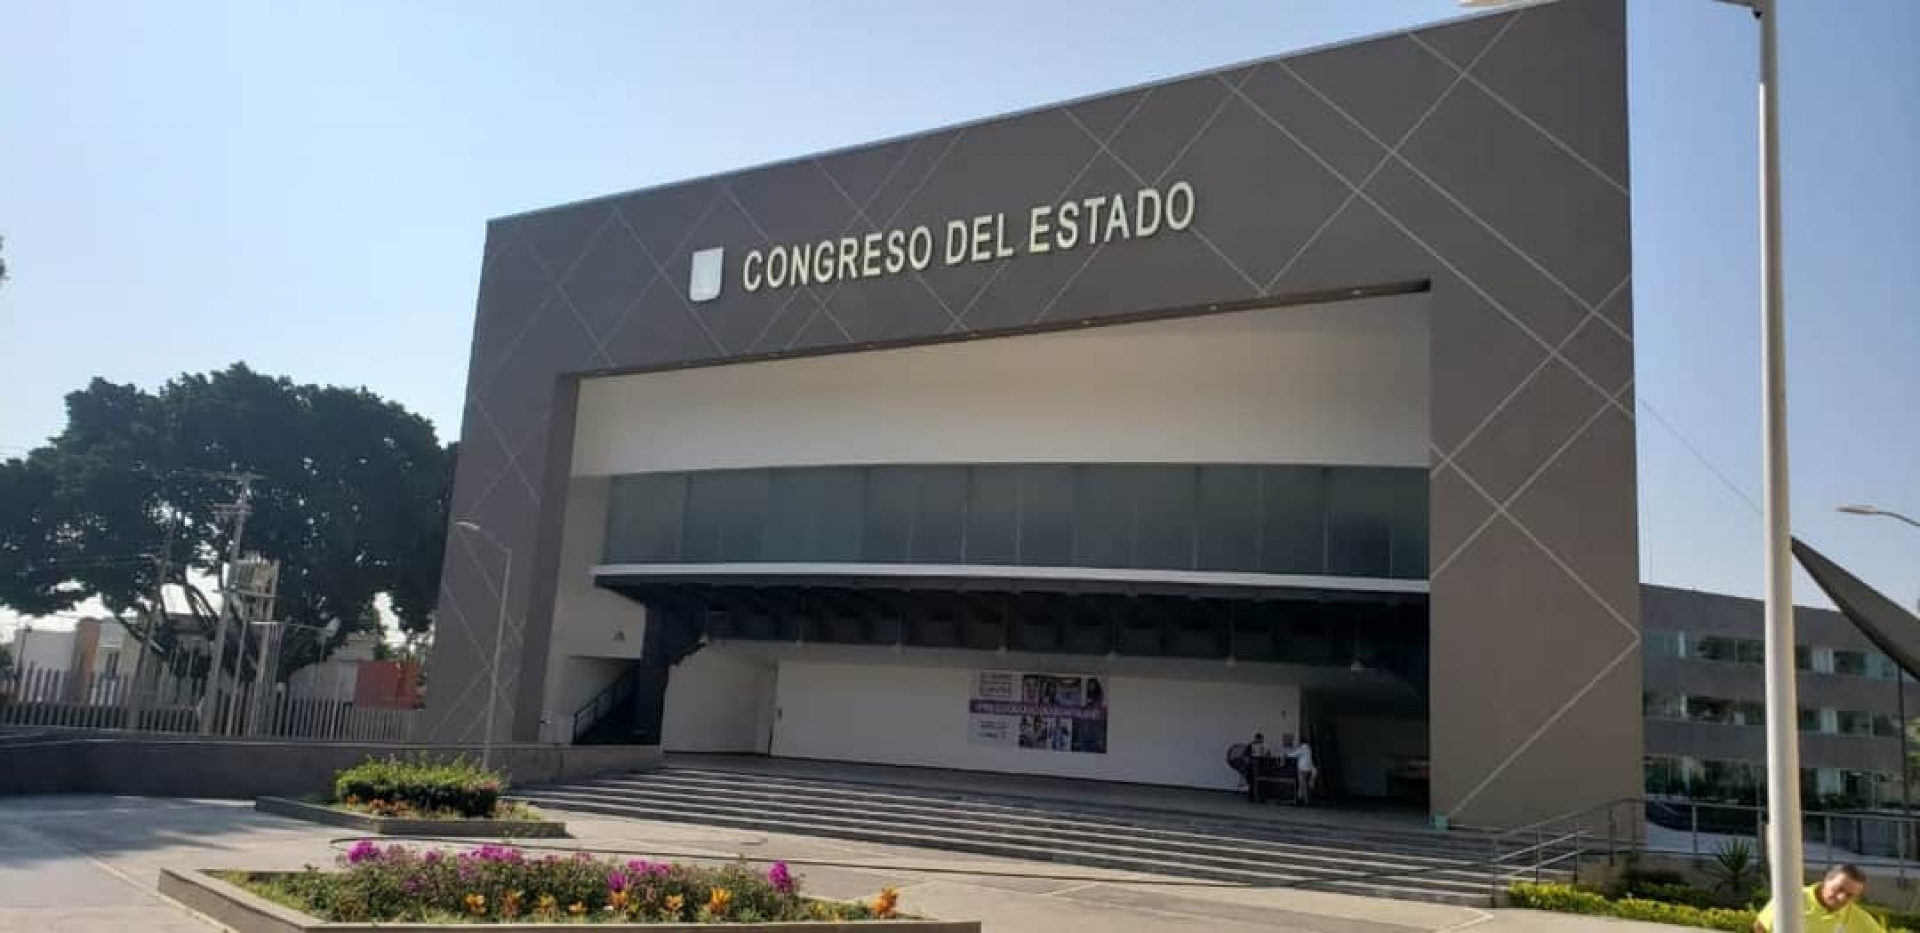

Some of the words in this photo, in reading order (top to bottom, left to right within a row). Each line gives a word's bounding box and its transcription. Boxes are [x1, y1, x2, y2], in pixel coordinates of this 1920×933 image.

[743, 226, 932, 292] CONGRESO
[945, 212, 1014, 266] DEL
[1029, 181, 1195, 254] ESTADO
